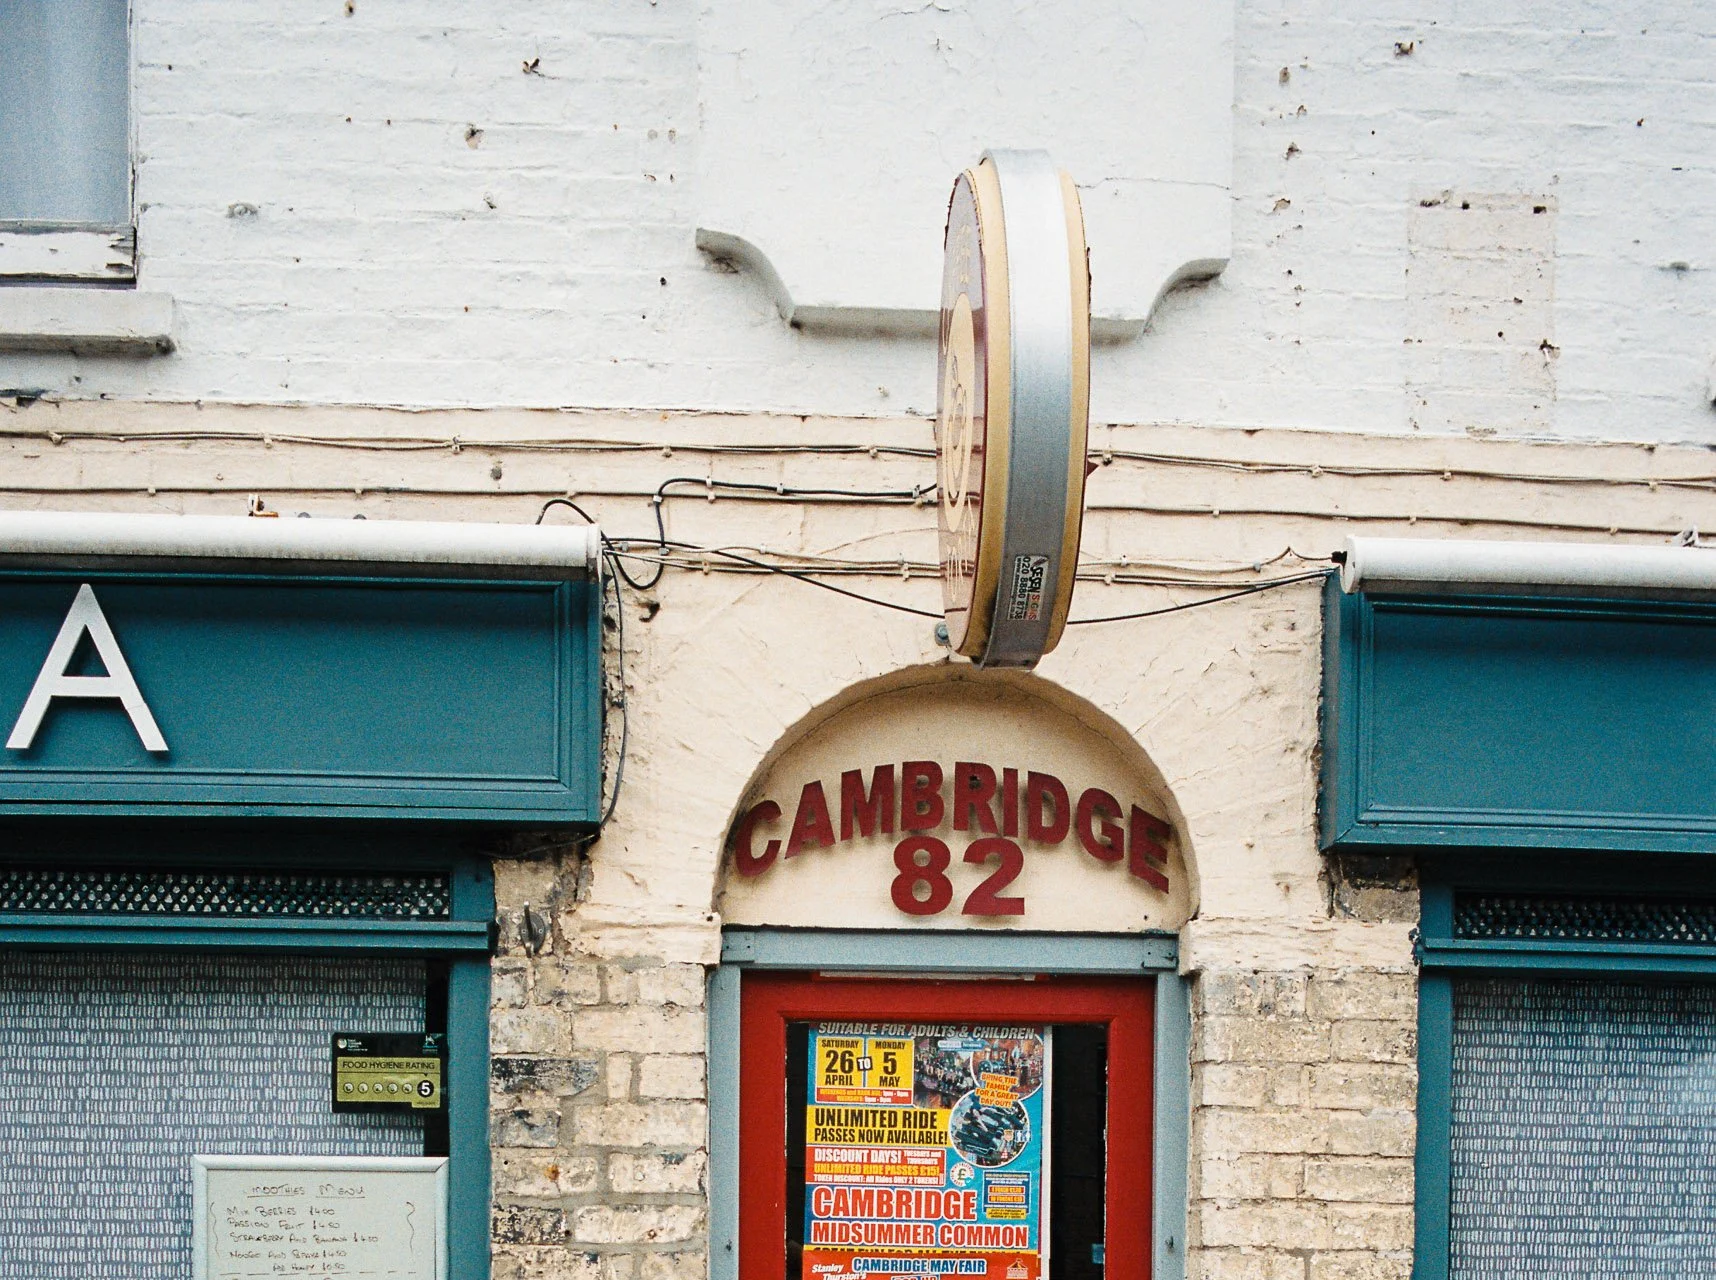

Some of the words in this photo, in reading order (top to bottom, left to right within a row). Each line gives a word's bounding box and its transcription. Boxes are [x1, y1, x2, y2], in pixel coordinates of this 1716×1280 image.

[1021, 557, 1031, 574] 020
[6, 583, 168, 752] A
[735, 760, 1171, 894] CAMBRIDGE
[891, 836, 1025, 916] 82
[819, 1023, 879, 1035] SUITABLE
[882, 1024, 906, 1036] FOR
[908, 1024, 955, 1037] ADULTS
[958, 1027, 969, 1038] &
[972, 1026, 1035, 1039] CHILDREN
[821, 1040, 859, 1049] SATURDAY
[875, 1041, 906, 1049] MONDAY
[342, 1061, 367, 1069] FOOD
[369, 1061, 405, 1069] HYGIENE
[406, 1061, 435, 1069] RATING
[825, 1050, 854, 1074] 26
[857, 1058, 871, 1068] TO
[883, 1052, 897, 1074] 5
[824, 1076, 854, 1086] APRIL
[879, 1077, 901, 1087] MAY
[982, 1074, 1003, 1084] BRING
[1003, 1076, 1017, 1085] THE
[986, 1081, 1010, 1090] FAMILY
[420, 1082, 431, 1095] 5
[976, 1089, 990, 1097] FOR
[998, 1091, 1019, 1101] GREAT
[980, 1098, 996, 1106] DAY
[998, 1099, 1012, 1107] OUT!
[815, 1108, 898, 1129] UNLIMITED
[902, 1111, 937, 1129] RIDE
[814, 1129, 856, 1143] PASSES
[858, 1130, 886, 1144] NOW
[887, 1130, 947, 1145] AVAILABLE!
[814, 1148, 868, 1163] DISCOUNT
[870, 1149, 901, 1163] DAYS!
[814, 1164, 862, 1175] UNLIMITED
[864, 1165, 882, 1175] RIDE
[883, 1166, 918, 1176] PASSES
[920, 1166, 940, 1177] £15!
[814, 1187, 976, 1220] CAMBRIDGE
[812, 1222, 935, 1245] MIDSUMMER
[940, 1225, 1028, 1247] COMMON
[812, 1264, 844, 1273] Stanley
[853, 1259, 928, 1272] CAMBRIDGE
[930, 1260, 958, 1272] MAY
[959, 1260, 985, 1273] FAIR
